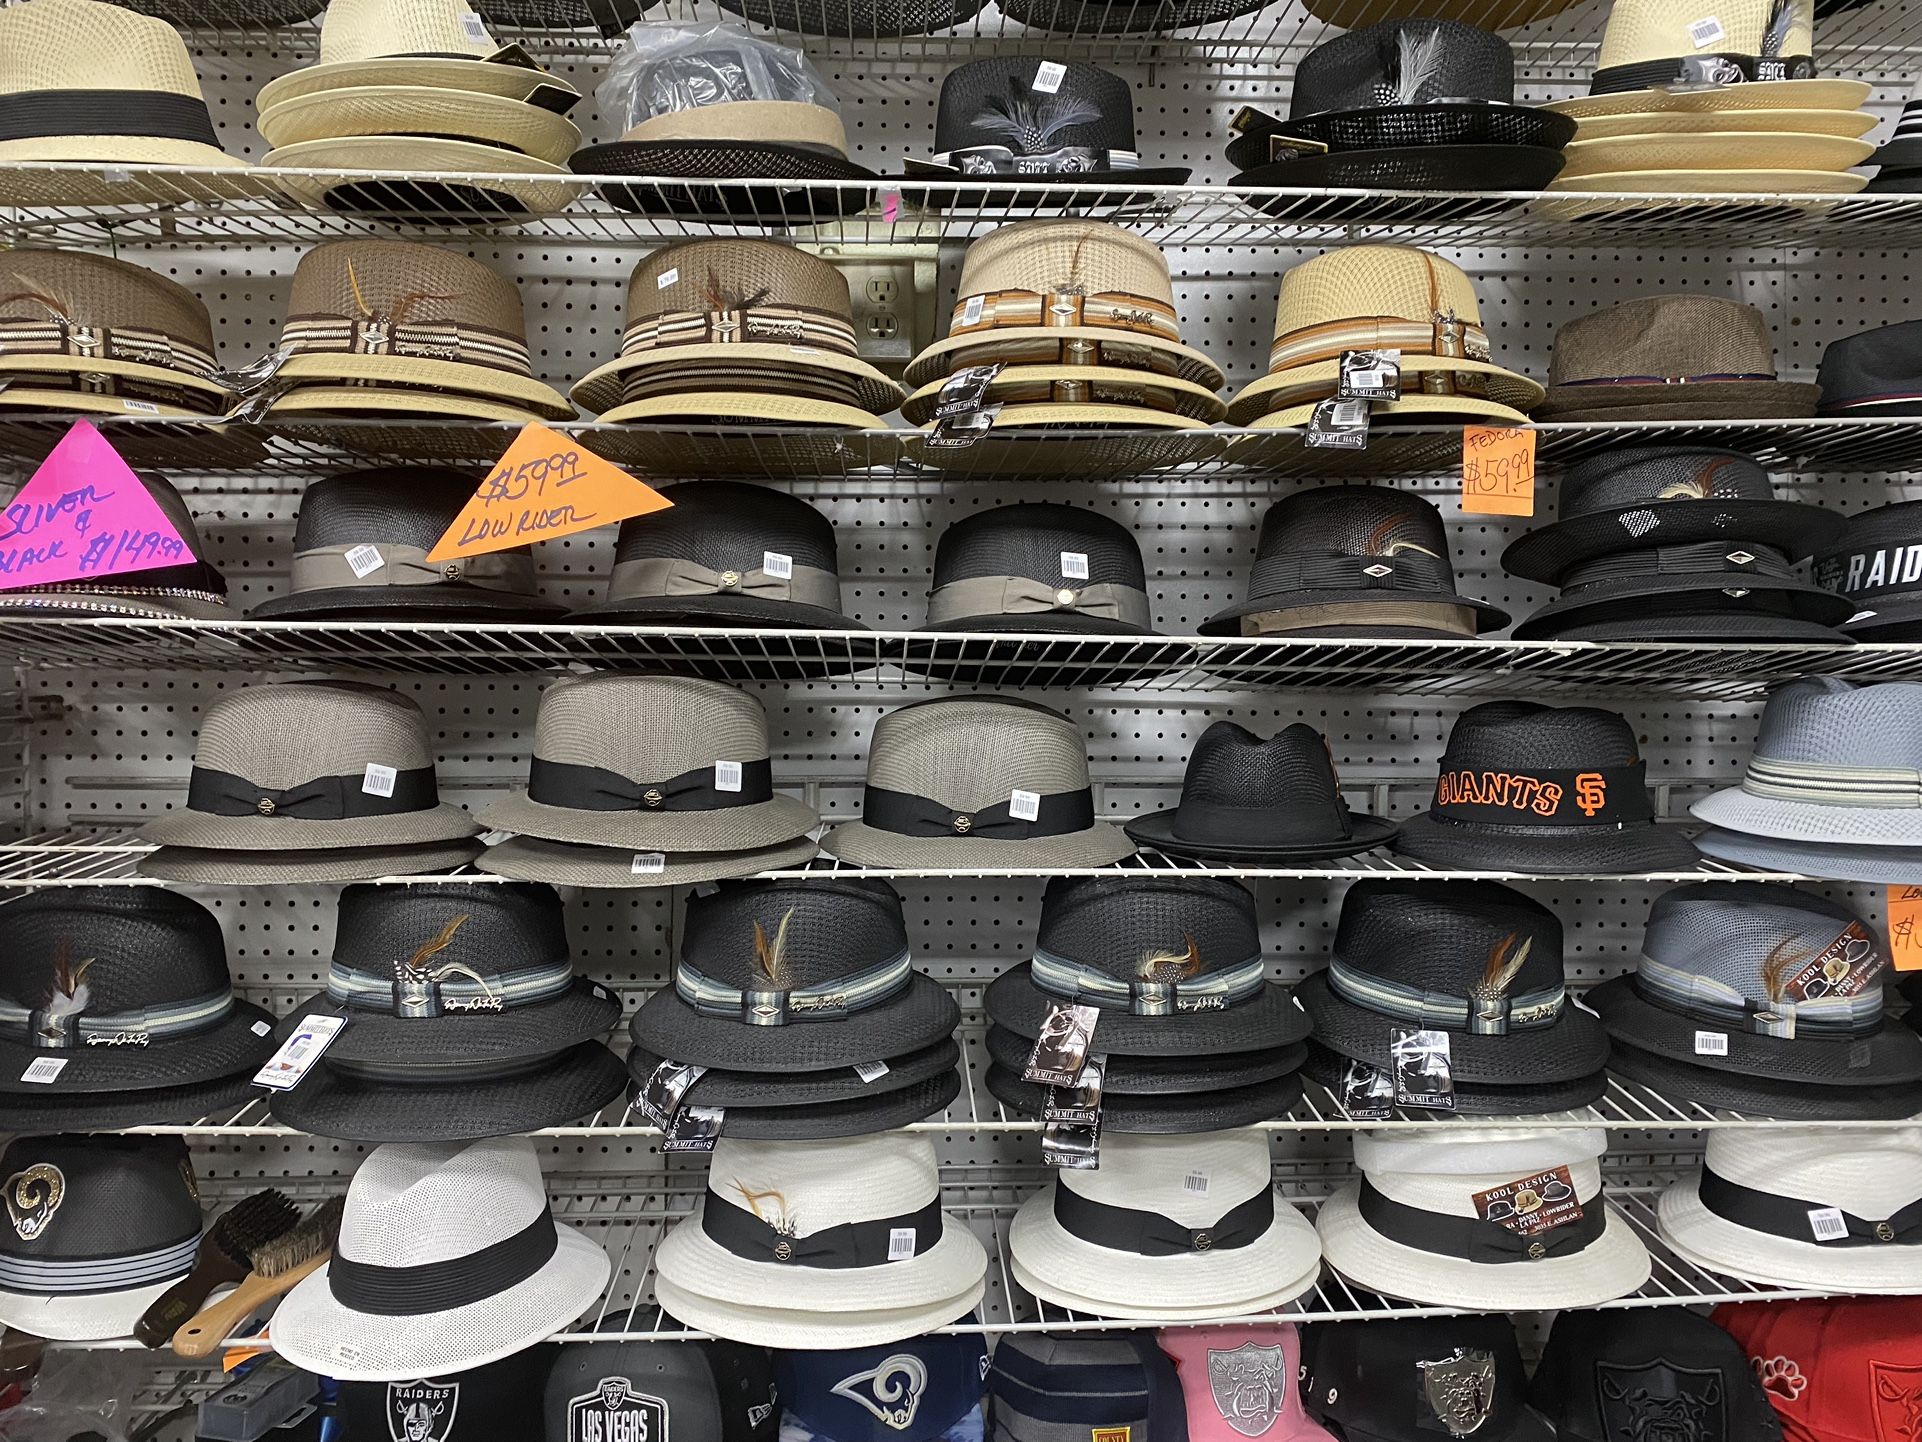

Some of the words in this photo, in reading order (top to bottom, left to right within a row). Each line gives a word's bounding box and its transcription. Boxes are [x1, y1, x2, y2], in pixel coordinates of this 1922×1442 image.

[1341, 388, 1373, 397] SUMMIT
[1376, 389, 1397, 399] HATS
[1309, 432, 1340, 444] SUMMIT
[1342, 434, 1363, 446] HATS
[1469, 428, 1524, 452] FEDORA
[1438, 771, 1564, 817] GIANTS
[1796, 963, 1821, 987] KOOL
[1820, 932, 1854, 964] DESIGN
[1025, 1068, 1053, 1080] SUMMIT
[1054, 1073, 1073, 1086] HATS
[1398, 1093, 1430, 1104] SUMMIT
[1432, 1095, 1452, 1106] HATS
[1044, 1109, 1075, 1120] SUMMIT
[1076, 1110, 1095, 1122] HATS
[663, 1140, 694, 1151] SUMMIT
[694, 1140, 713, 1150] HATS
[1044, 1152, 1075, 1165] SUMMIT
[1486, 1186, 1514, 1202] KOOL
[1518, 1171, 1558, 1191] DESIGN
[1543, 1201, 1575, 1217] LOWRIDER
[396, 1388, 449, 1399] RAIDERS
[582, 1408, 602, 1442] LAS
[605, 1409, 648, 1442] VEGAS
